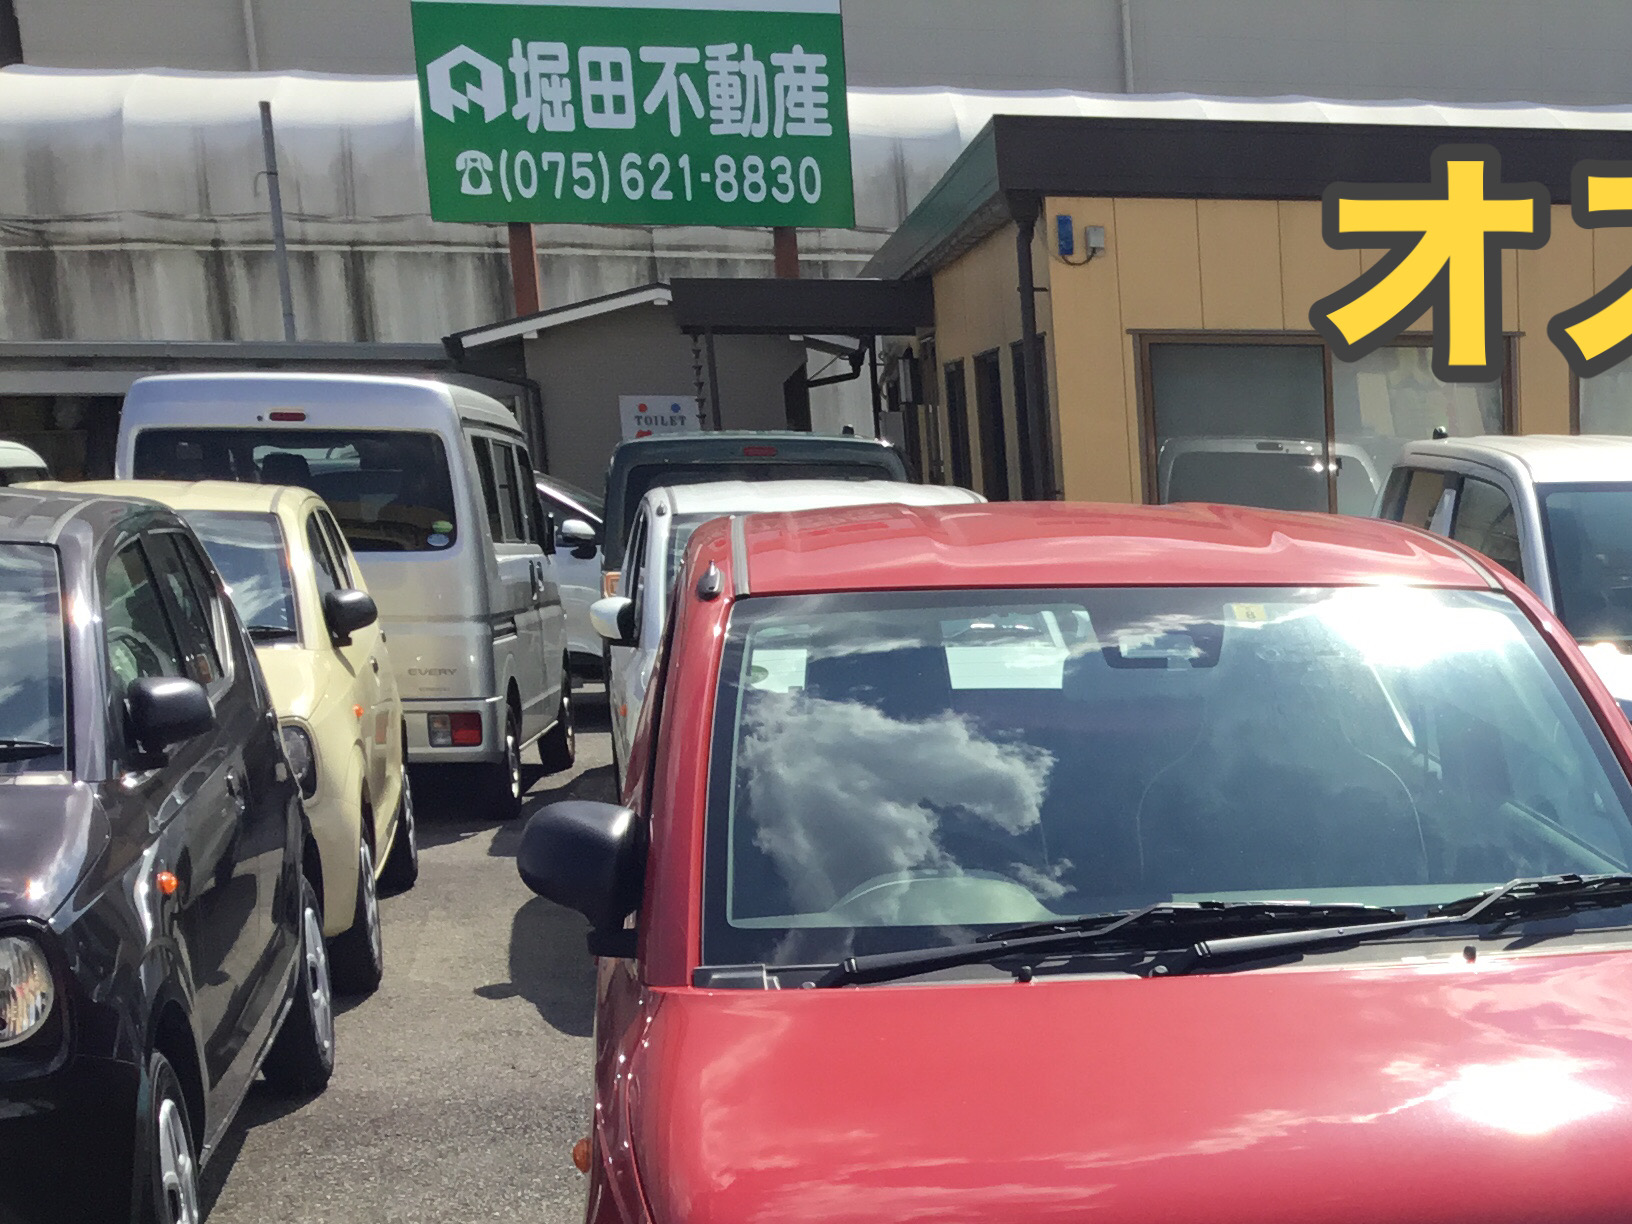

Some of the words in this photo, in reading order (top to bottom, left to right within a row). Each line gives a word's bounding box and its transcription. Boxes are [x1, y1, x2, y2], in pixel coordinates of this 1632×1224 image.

[507, 38, 833, 138] 堀田不動産
[634, 415, 687, 426] TOILET
[408, 667, 457, 676] EVERY
